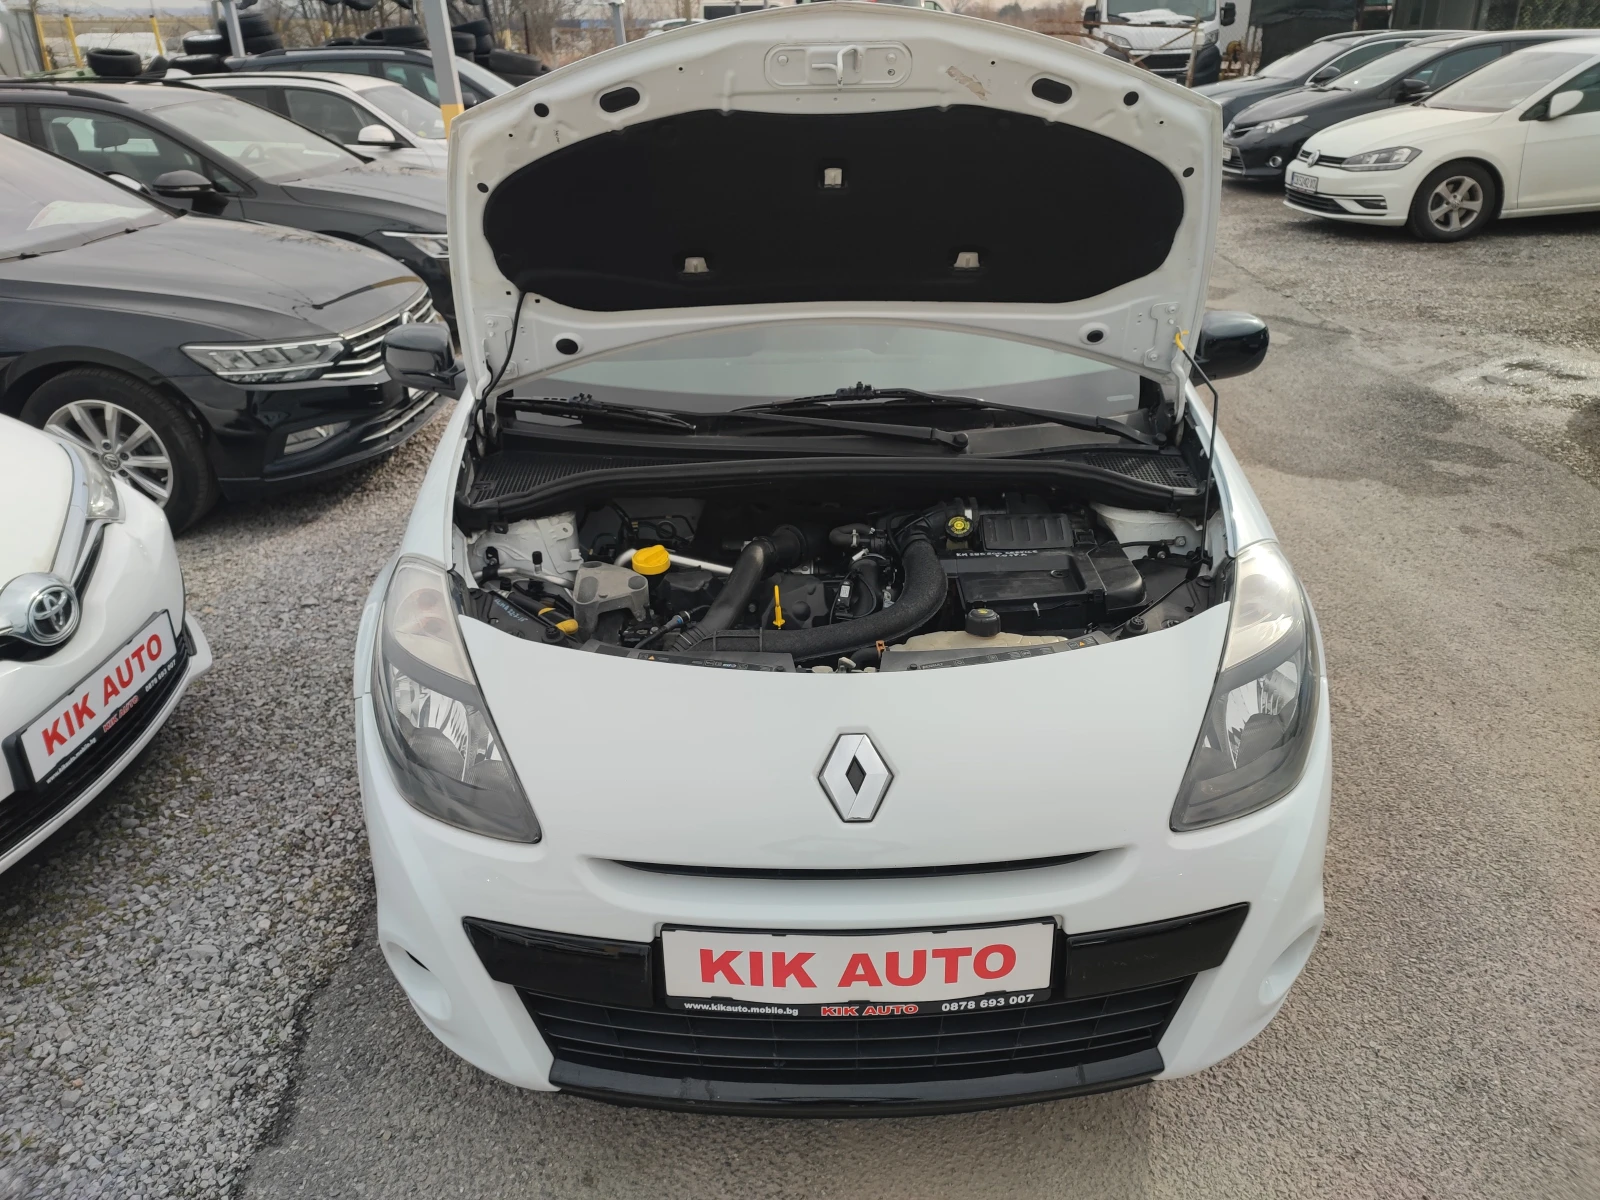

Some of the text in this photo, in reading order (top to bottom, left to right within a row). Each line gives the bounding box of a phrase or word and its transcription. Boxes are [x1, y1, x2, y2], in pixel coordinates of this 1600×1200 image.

[41, 634, 162, 757] KIK AUTO
[103, 695, 140, 733] KIK AUTO
[699, 944, 1017, 988] KIK AUTO
[684, 1002, 799, 1016] www.kikauto.mobile.bg
[821, 1004, 919, 1017] KIK AUTO
[941, 993, 1034, 1012] 0878 693 007
